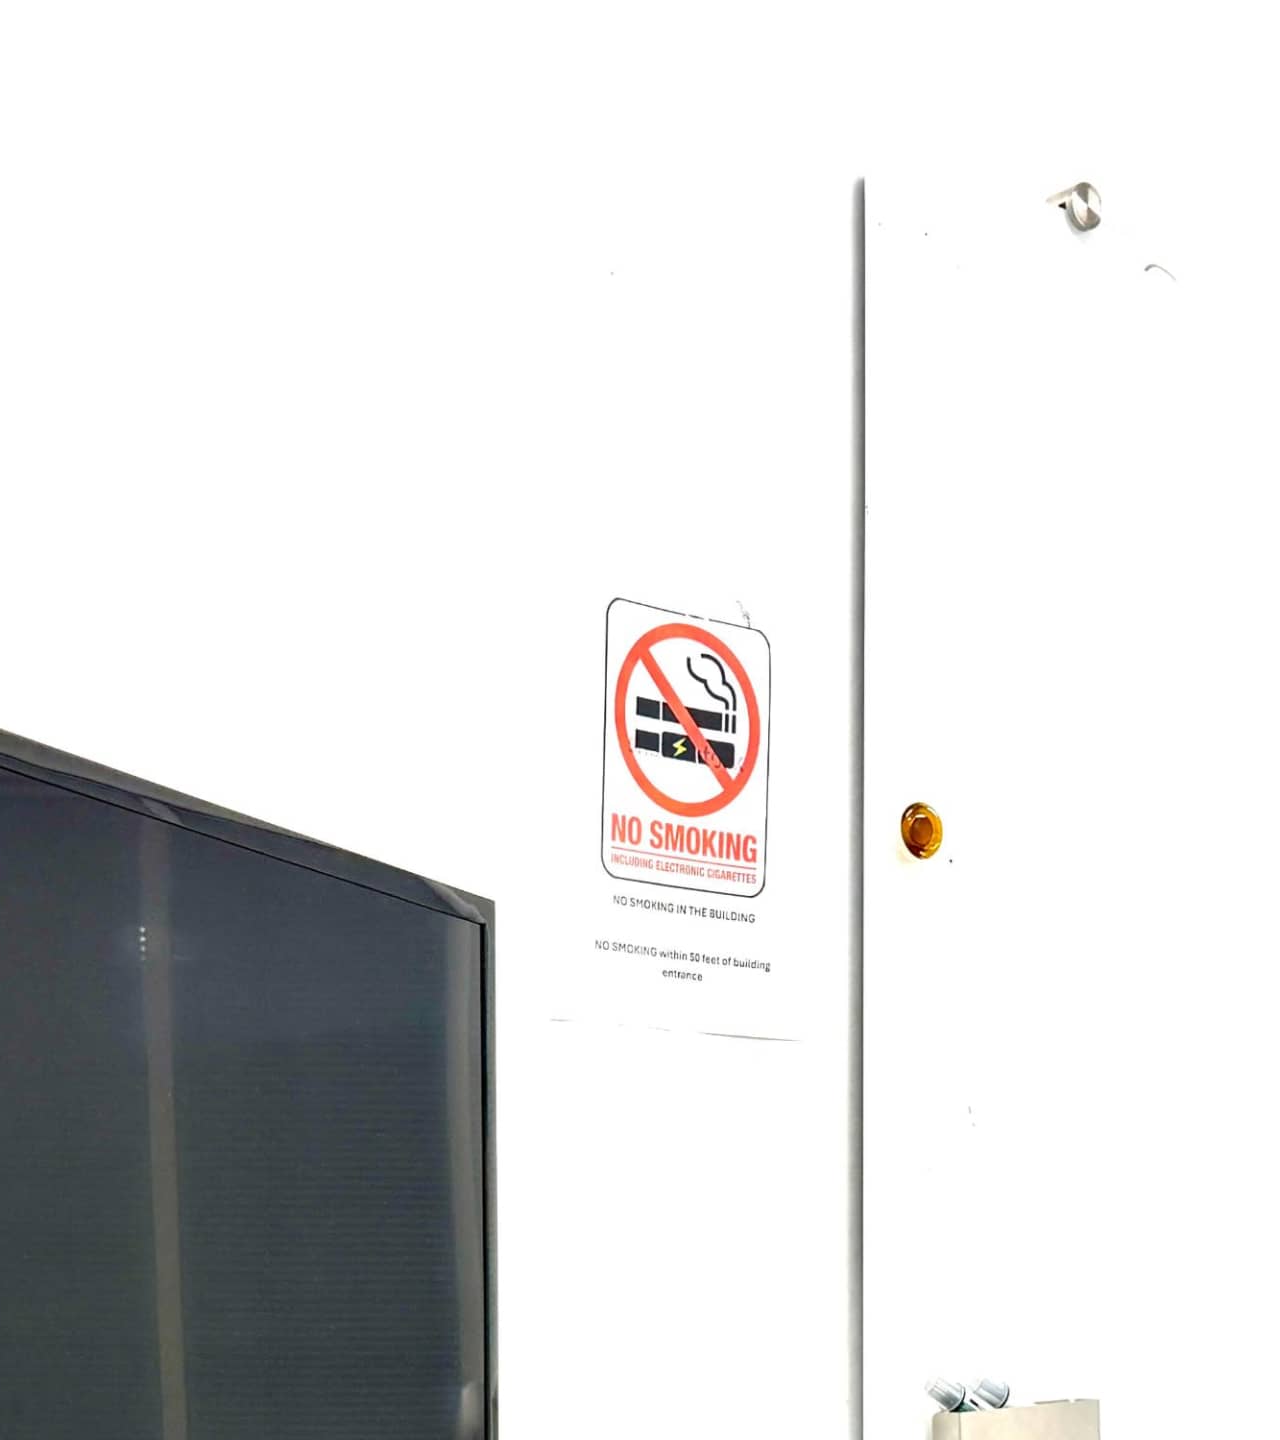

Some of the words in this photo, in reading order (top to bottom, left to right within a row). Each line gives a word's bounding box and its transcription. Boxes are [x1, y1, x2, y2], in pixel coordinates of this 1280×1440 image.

[611, 813, 642, 845] NO
[649, 820, 757, 863] SMOKING
[610, 853, 653, 870] INCLUDING
[656, 860, 705, 877] ELECTRONIC
[707, 868, 757, 884] CIGARETTES
[613, 895, 628, 906] NO
[630, 898, 674, 913] SMOKING
[676, 905, 687, 915] IN
[689, 906, 707, 918] THE
[709, 908, 756, 924] BUILDING
[595, 939, 610, 951] NO
[612, 942, 657, 957] SMOKING
[659, 949, 688, 961] within
[689, 952, 700, 963] 50
[702, 953, 720, 965] feet
[722, 957, 732, 966] of
[733, 958, 771, 973] building
[662, 969, 703, 982] entrance
